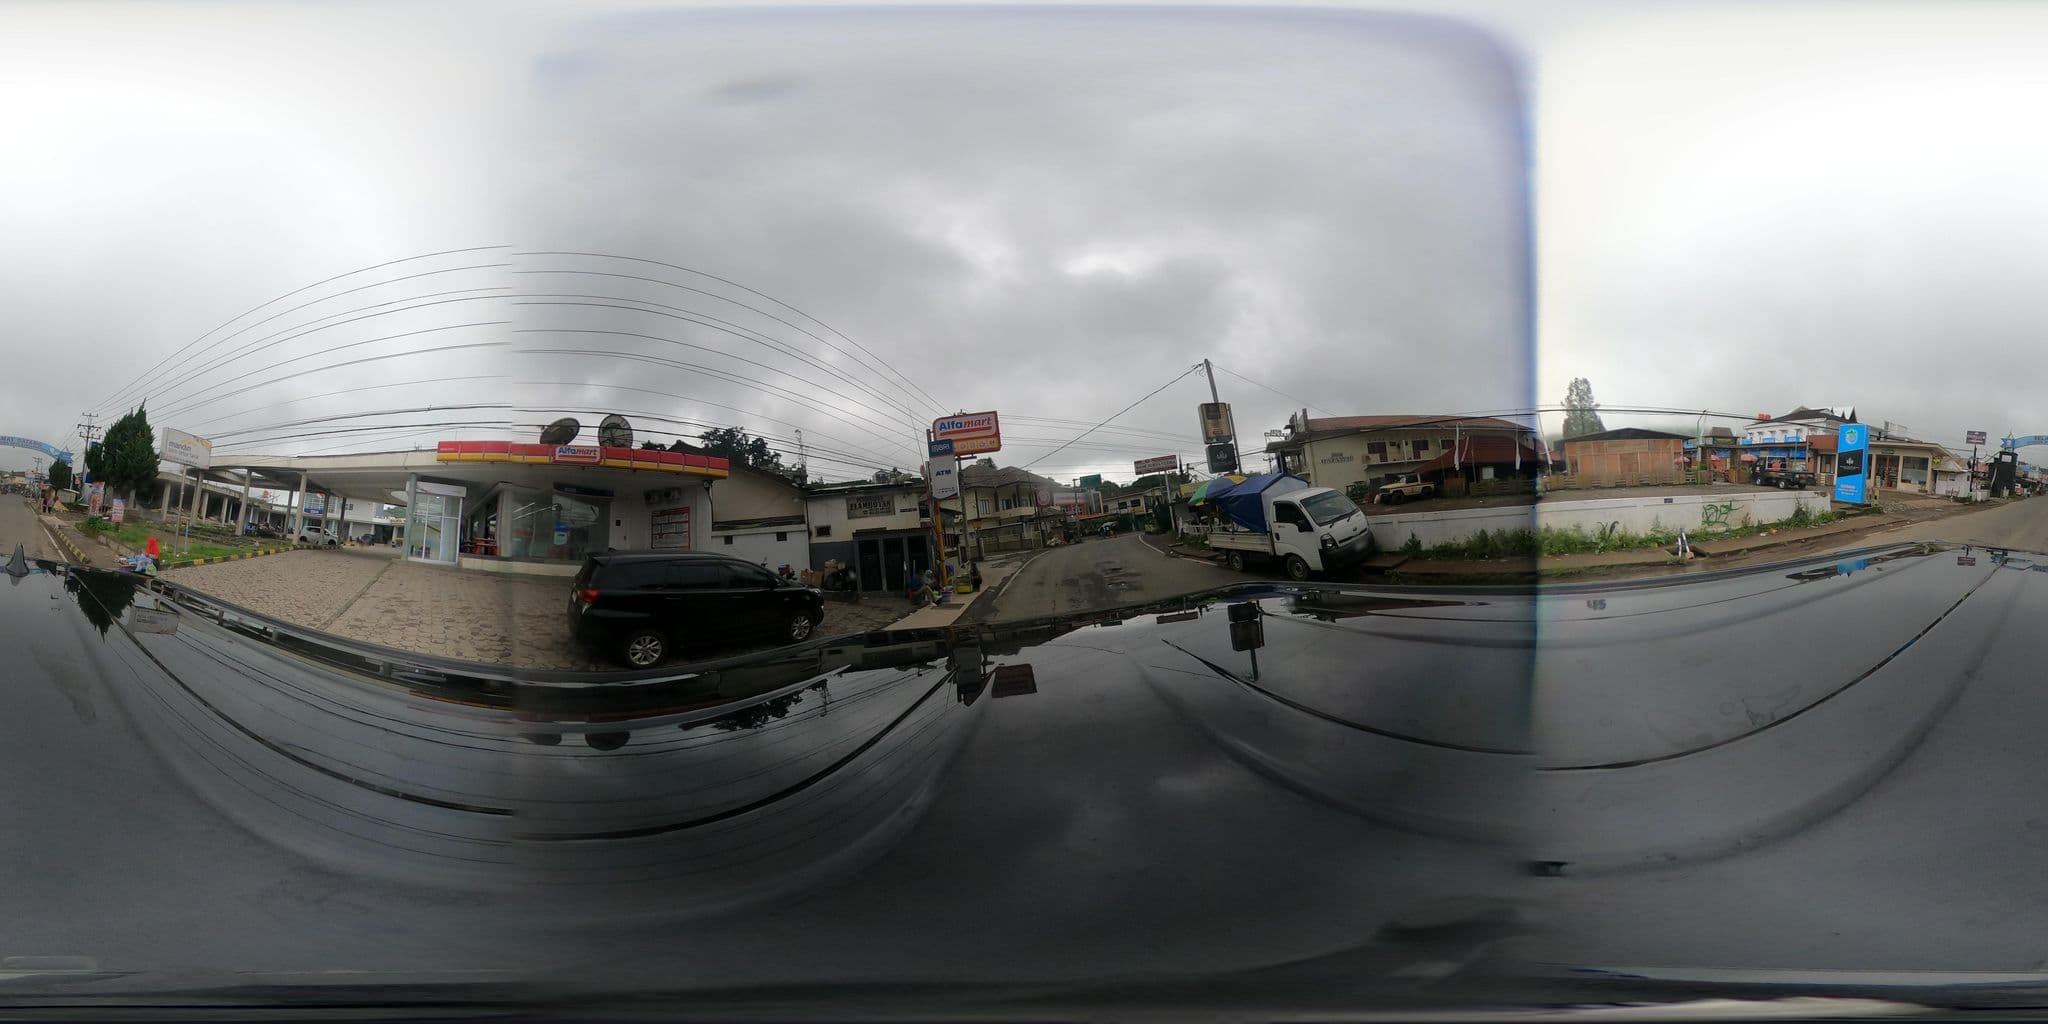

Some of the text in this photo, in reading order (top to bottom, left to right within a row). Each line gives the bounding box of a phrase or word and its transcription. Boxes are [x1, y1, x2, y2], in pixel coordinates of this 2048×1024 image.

[939, 417, 993, 430] Alfamart
[558, 447, 597, 455] Alfamart
[935, 469, 951, 477] ATM
